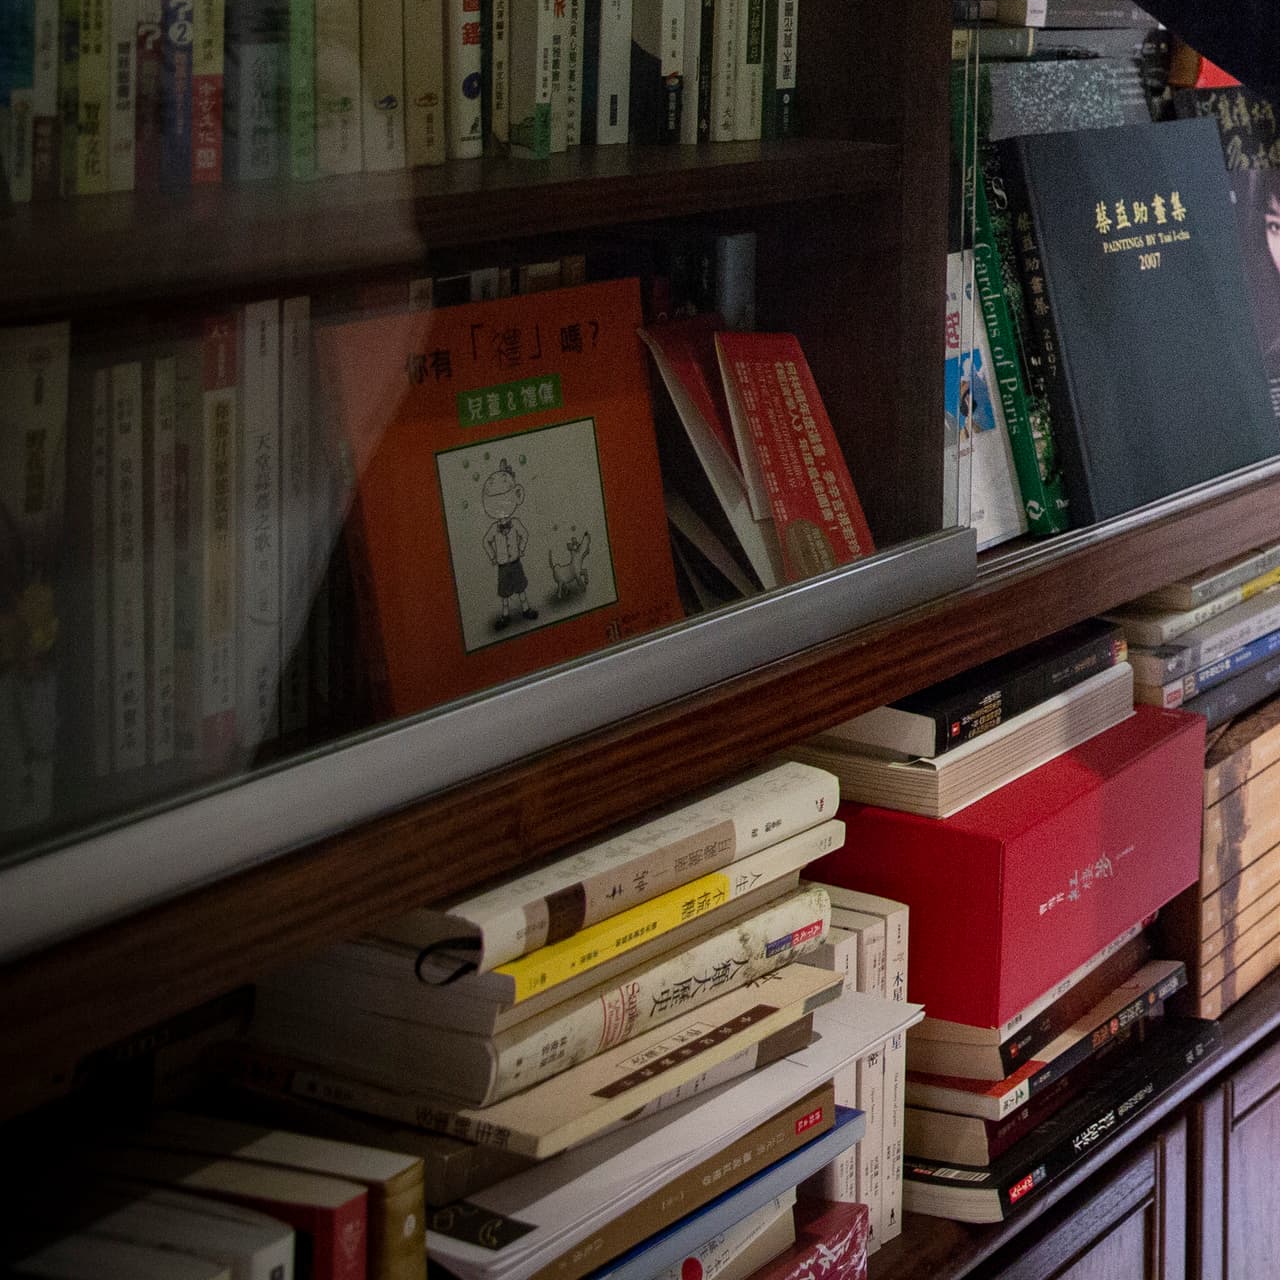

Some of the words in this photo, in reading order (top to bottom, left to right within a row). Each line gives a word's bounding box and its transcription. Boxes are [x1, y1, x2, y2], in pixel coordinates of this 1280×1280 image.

[1095, 190, 1187, 235] 蔡益助畫集
[1103, 236, 1144, 253] PAINTINGS
[1145, 233, 1157, 247] BY
[1138, 251, 1161, 271] 2007
[974, 241, 1002, 340] Gardens
[993, 345, 1015, 369] of
[998, 375, 1022, 436] Paris
[734, 871, 764, 894] 人生
[649, 956, 751, 1019] 人類大歷史
